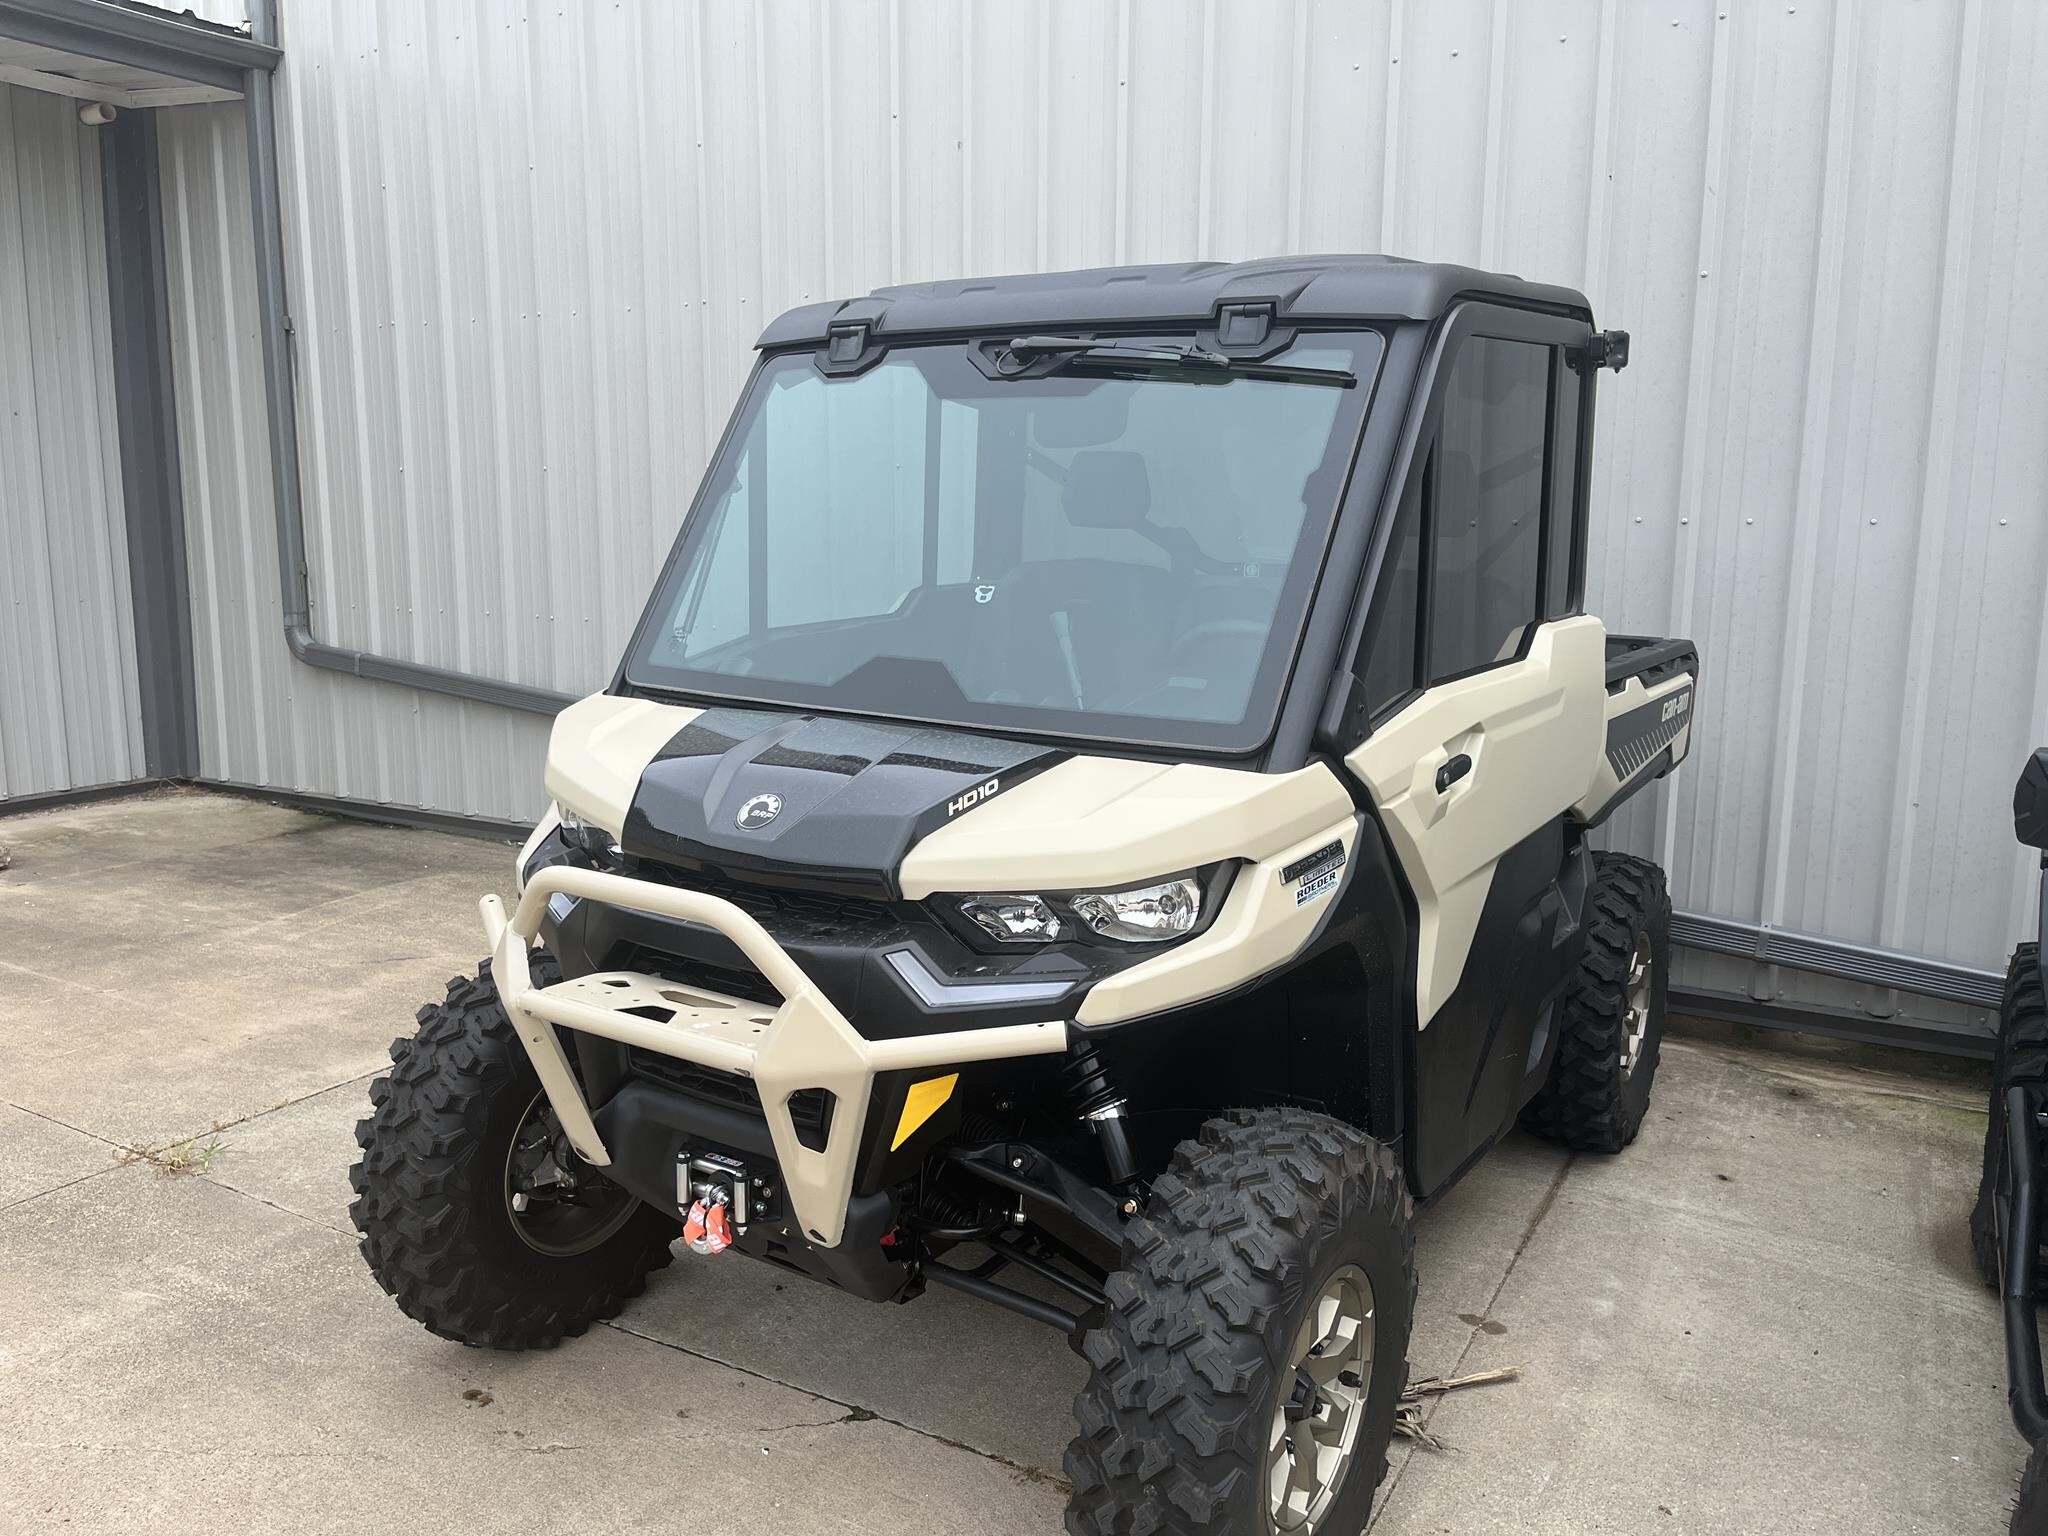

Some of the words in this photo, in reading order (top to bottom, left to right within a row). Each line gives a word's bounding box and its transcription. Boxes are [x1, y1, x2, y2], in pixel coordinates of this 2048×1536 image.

[948, 778, 999, 817] HD10
[750, 809, 774, 819] BRP
[1306, 857, 1343, 881] LIMITED
[1297, 871, 1336, 900] ROEDER
